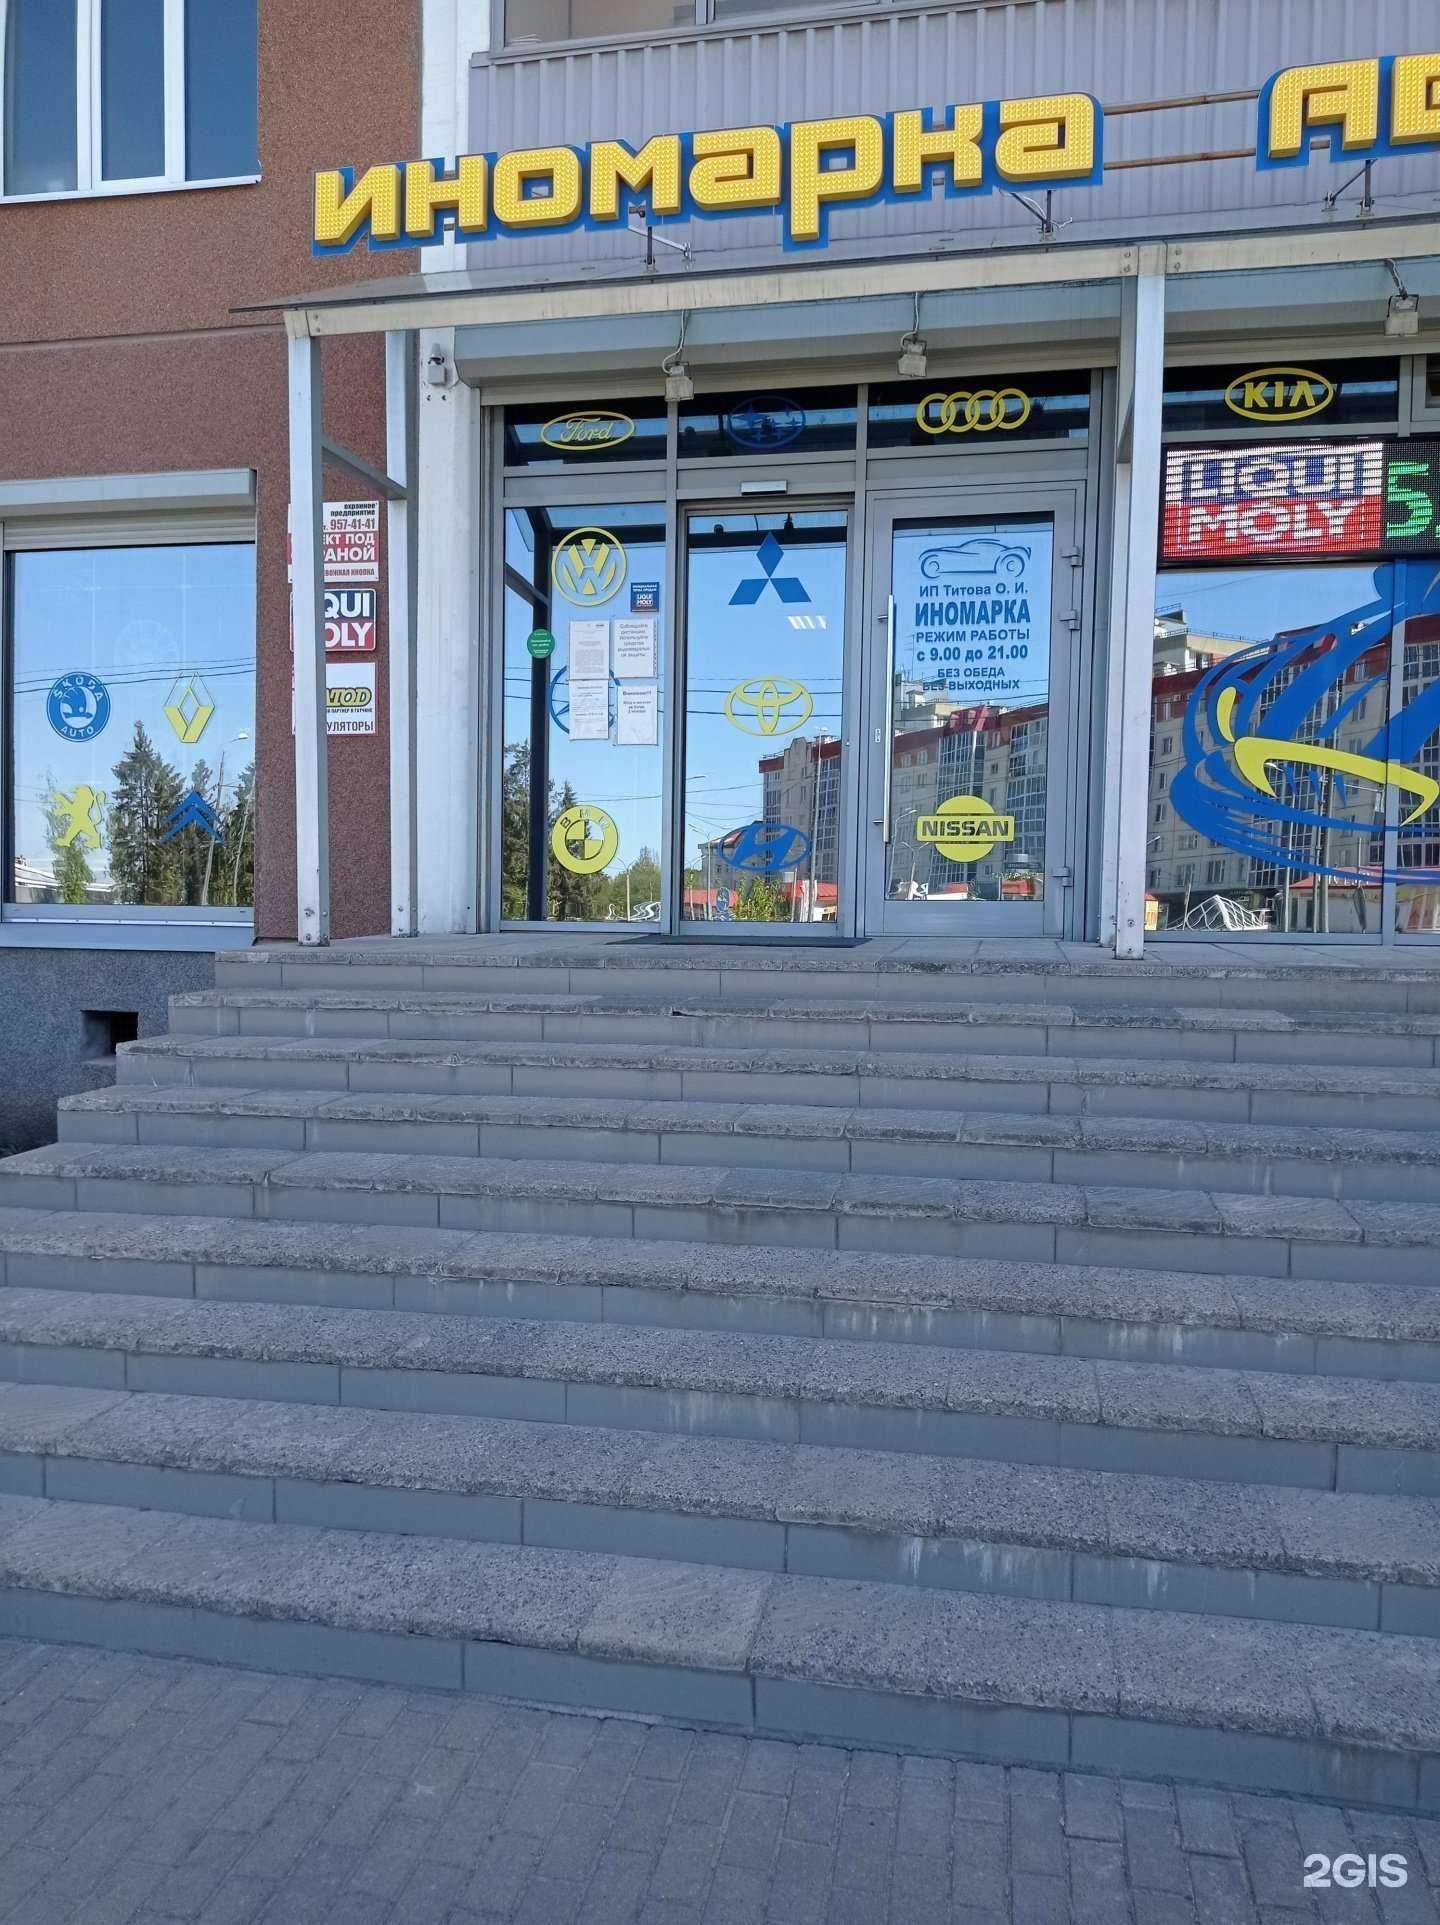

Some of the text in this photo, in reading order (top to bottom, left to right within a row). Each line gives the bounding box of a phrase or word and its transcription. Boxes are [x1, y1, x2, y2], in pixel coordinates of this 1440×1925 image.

[1244, 380, 1317, 409] KIA
[561, 417, 614, 442] Ford
[1189, 455, 1356, 498] LIQUI
[330, 518, 375, 530] 957-41-41
[1188, 500, 1362, 542] MOLY
[323, 533, 375, 546] КТ ПОД
[323, 546, 375, 561] АНОЙ
[919, 582, 1029, 597] ИП Титова О. И.
[915, 599, 1031, 627] ИНОМАРКА
[916, 628, 1030, 643] РЕЖИМ РАБОТЫ
[929, 647, 961, 661] 9.00
[965, 649, 983, 663] до
[987, 645, 1028, 660] 21.00
[937, 667, 1005, 679] БЕЗ ОБЕДА
[948, 680, 1020, 692] ВЫХОДНЫХ
[60, 725, 94, 737] AUTO
[921, 820, 1009, 837] NISSAN
